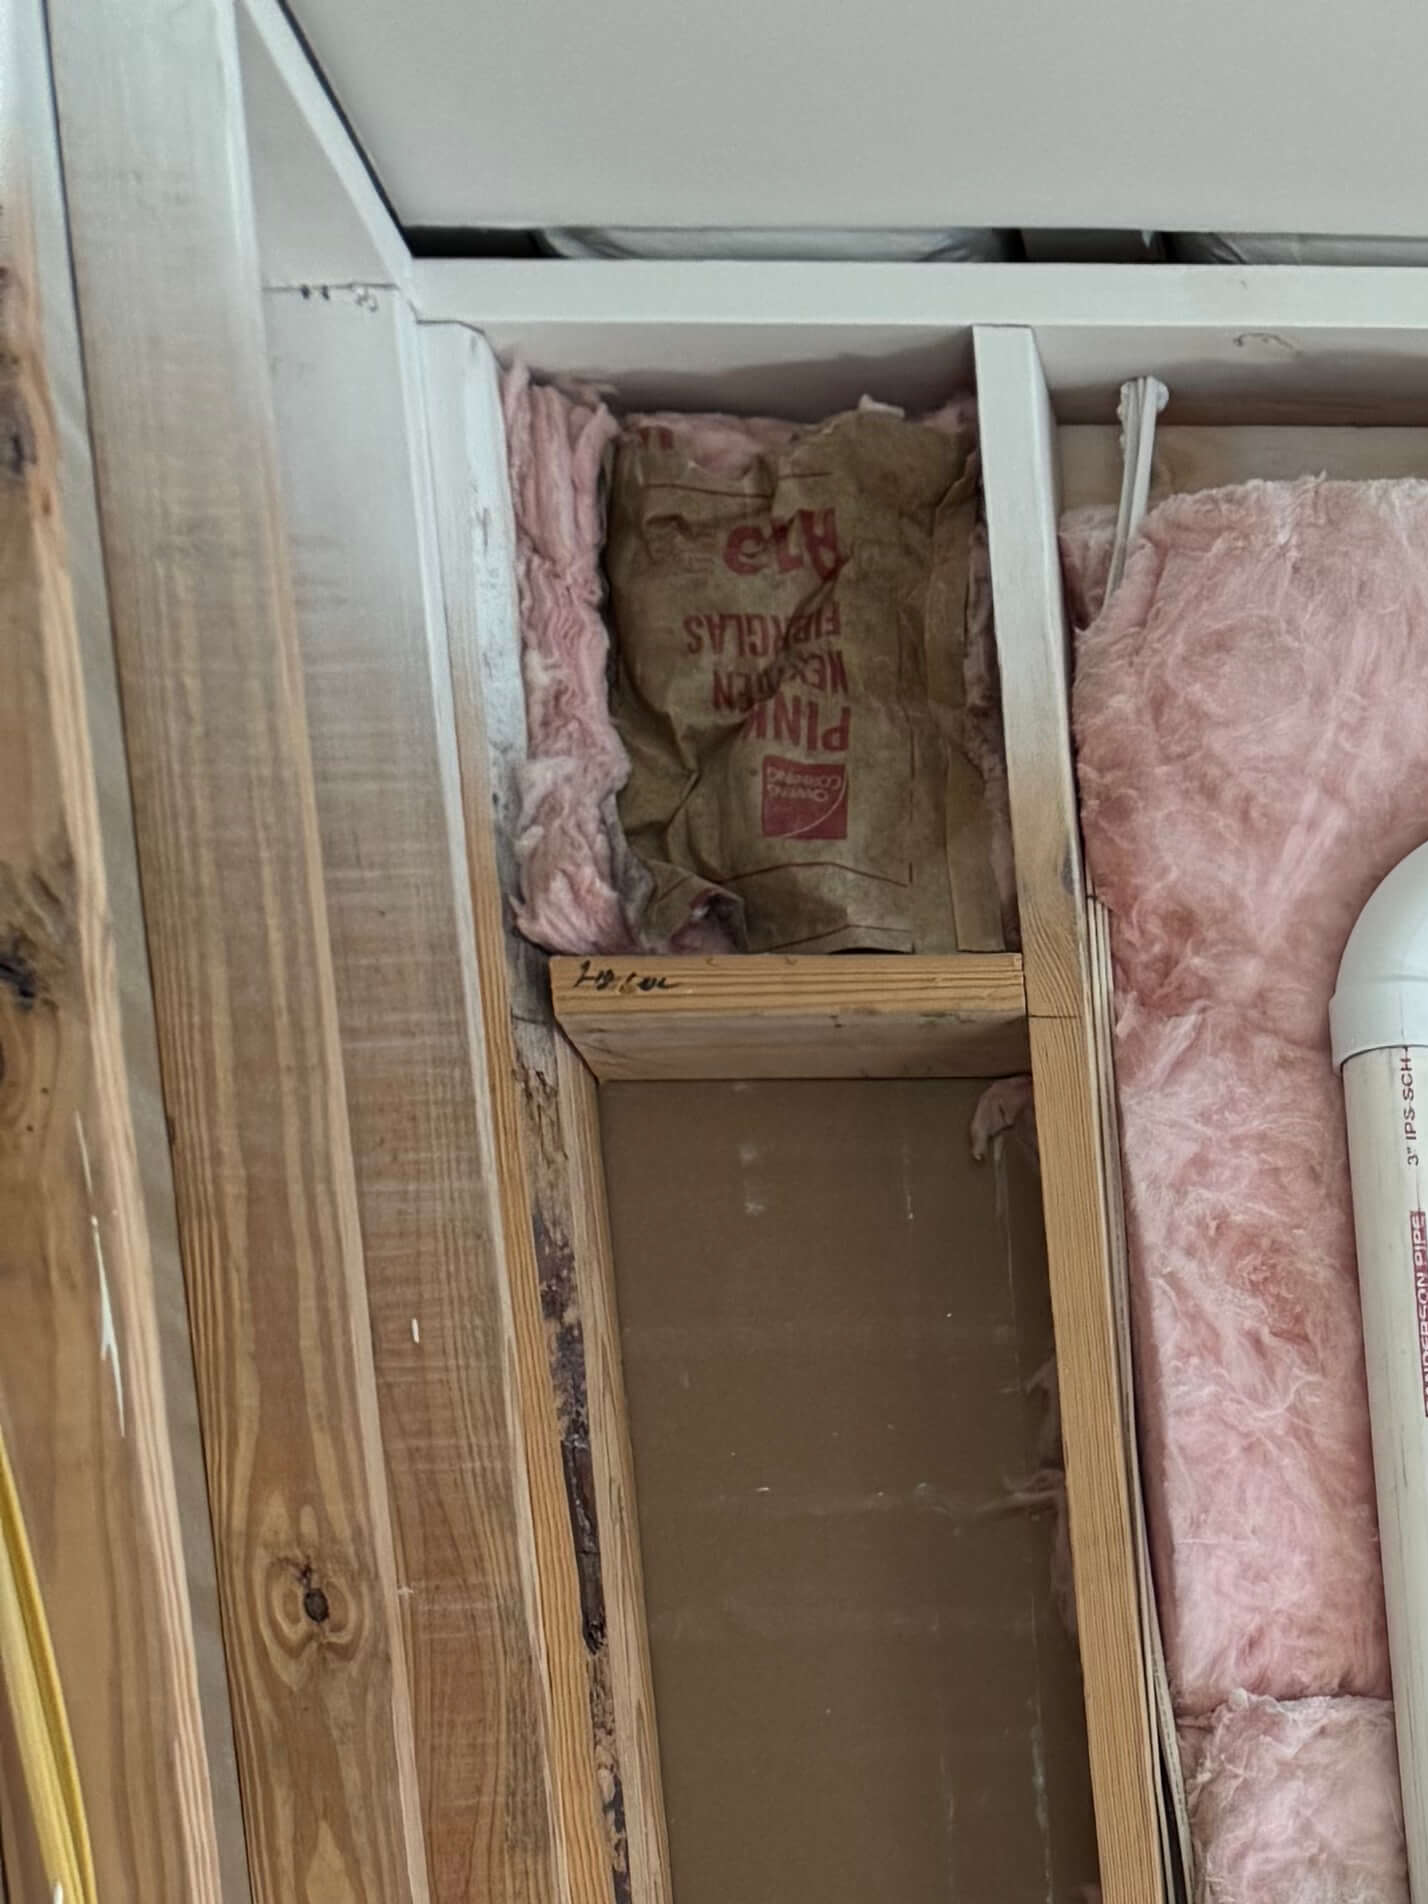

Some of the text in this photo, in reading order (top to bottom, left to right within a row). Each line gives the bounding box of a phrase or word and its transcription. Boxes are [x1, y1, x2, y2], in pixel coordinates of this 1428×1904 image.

[1400, 1057, 1415, 1101] SCH
[1403, 1108, 1417, 1140] IPS
[1410, 1211, 1427, 1267] PIPE
